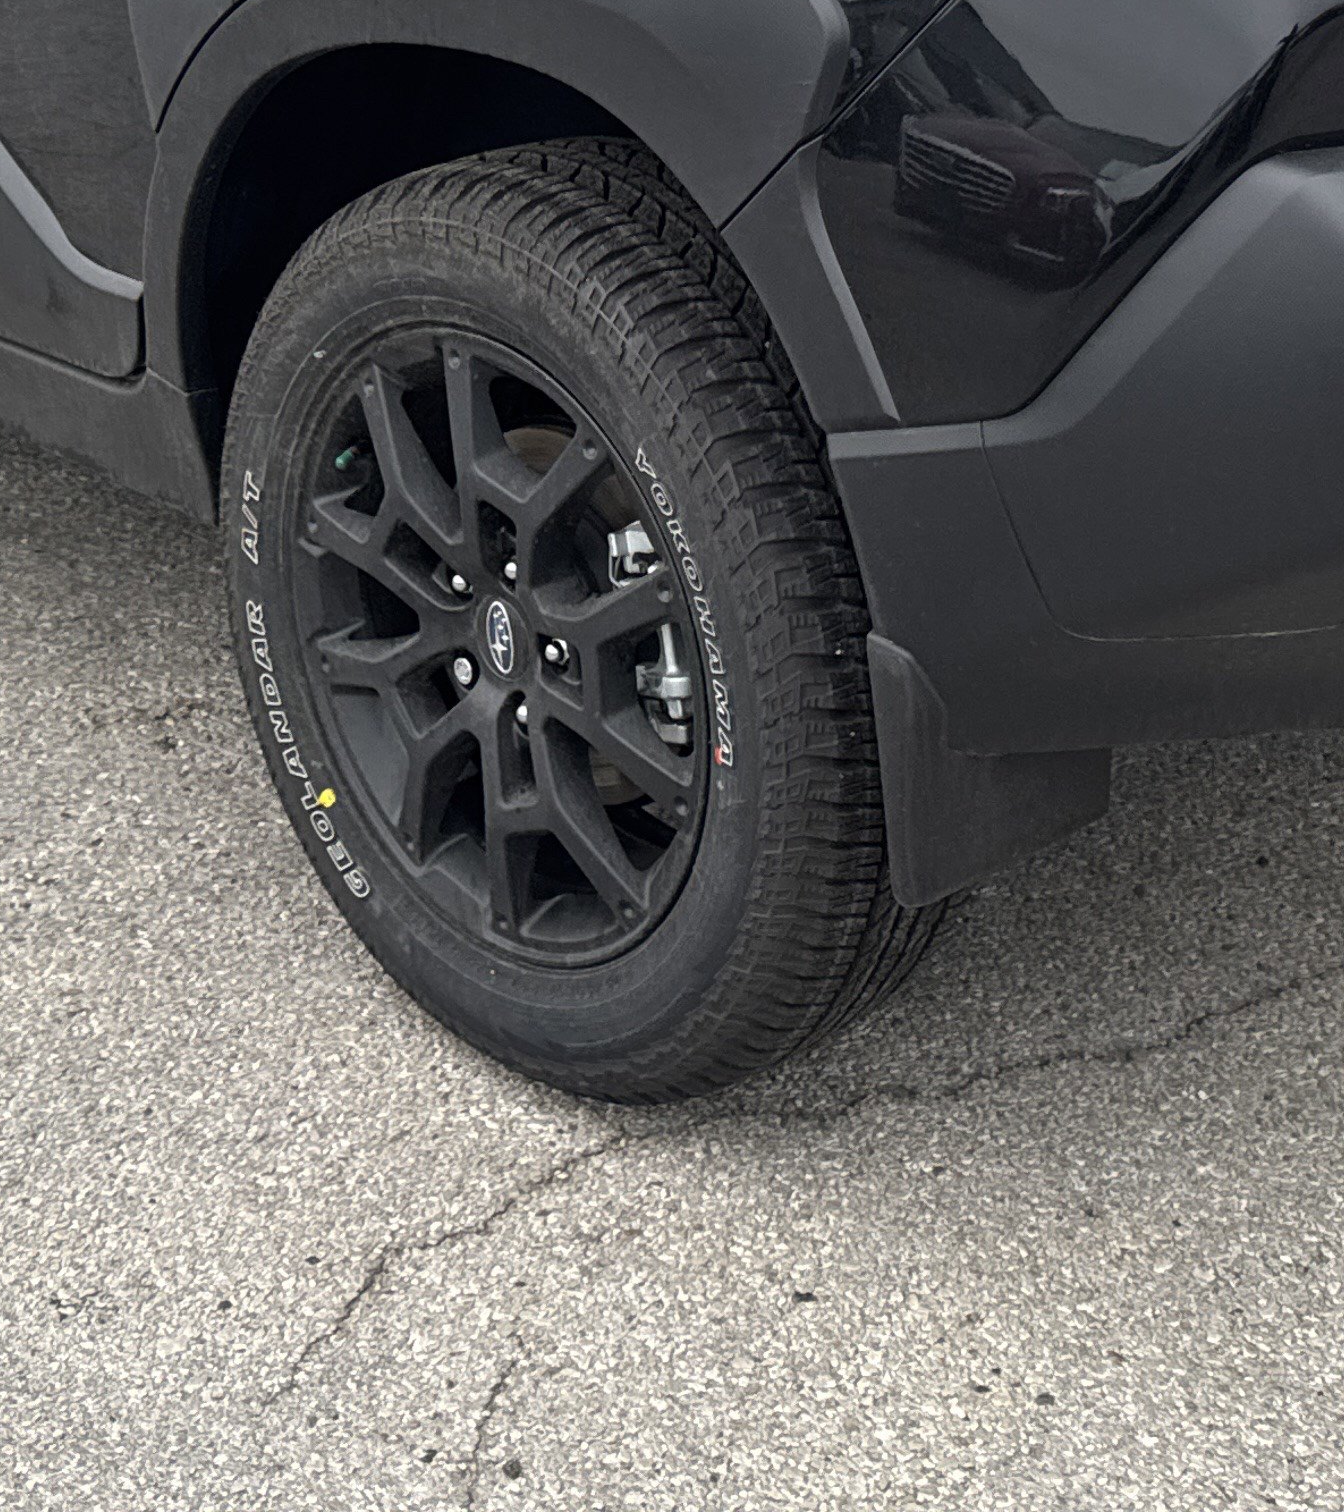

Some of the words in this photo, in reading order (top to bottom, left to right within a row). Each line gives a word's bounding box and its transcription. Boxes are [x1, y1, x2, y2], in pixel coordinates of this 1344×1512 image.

[241, 471, 261, 564] A/T
[635, 448, 733, 767] YOKOHAMA
[246, 600, 370, 899] GEOLANDAR
